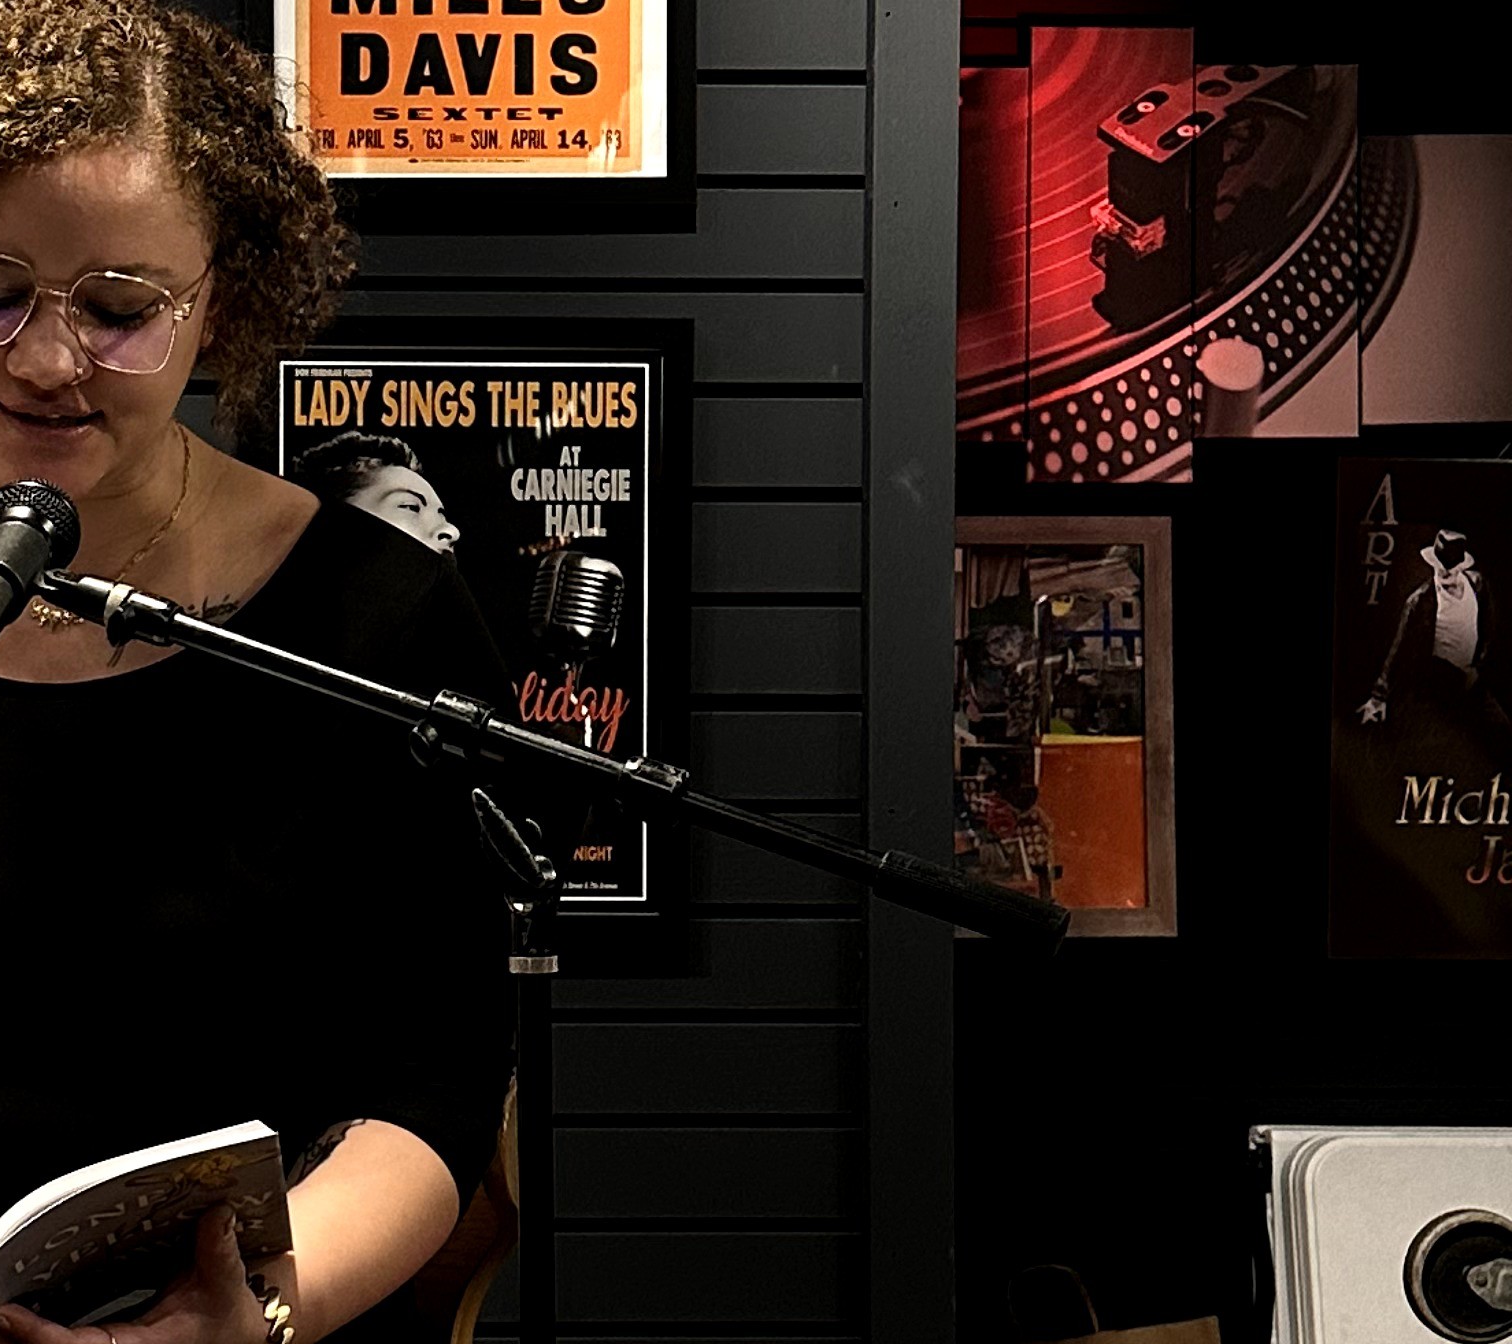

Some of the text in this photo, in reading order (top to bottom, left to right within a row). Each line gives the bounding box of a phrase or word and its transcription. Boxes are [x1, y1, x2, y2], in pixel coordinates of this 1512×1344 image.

[340, 33, 598, 96] DAVIS
[373, 107, 564, 121] SEXTET
[347, 129, 385, 150] APRIL
[392, 129, 414, 152] 5,
[422, 129, 443, 150] '63
[470, 129, 503, 150] SUN.
[511, 129, 548, 150] APRIL
[557, 129, 593, 152] 14,
[294, 379, 638, 429] LADY SINGS THE BLUES
[560, 445, 581, 467] AT
[511, 468, 631, 502] CARNEGIE
[545, 504, 607, 537] HALL
[519, 671, 631, 753] liday
[1395, 773, 1512, 825] Mich
[573, 846, 613, 862] NIGHT
